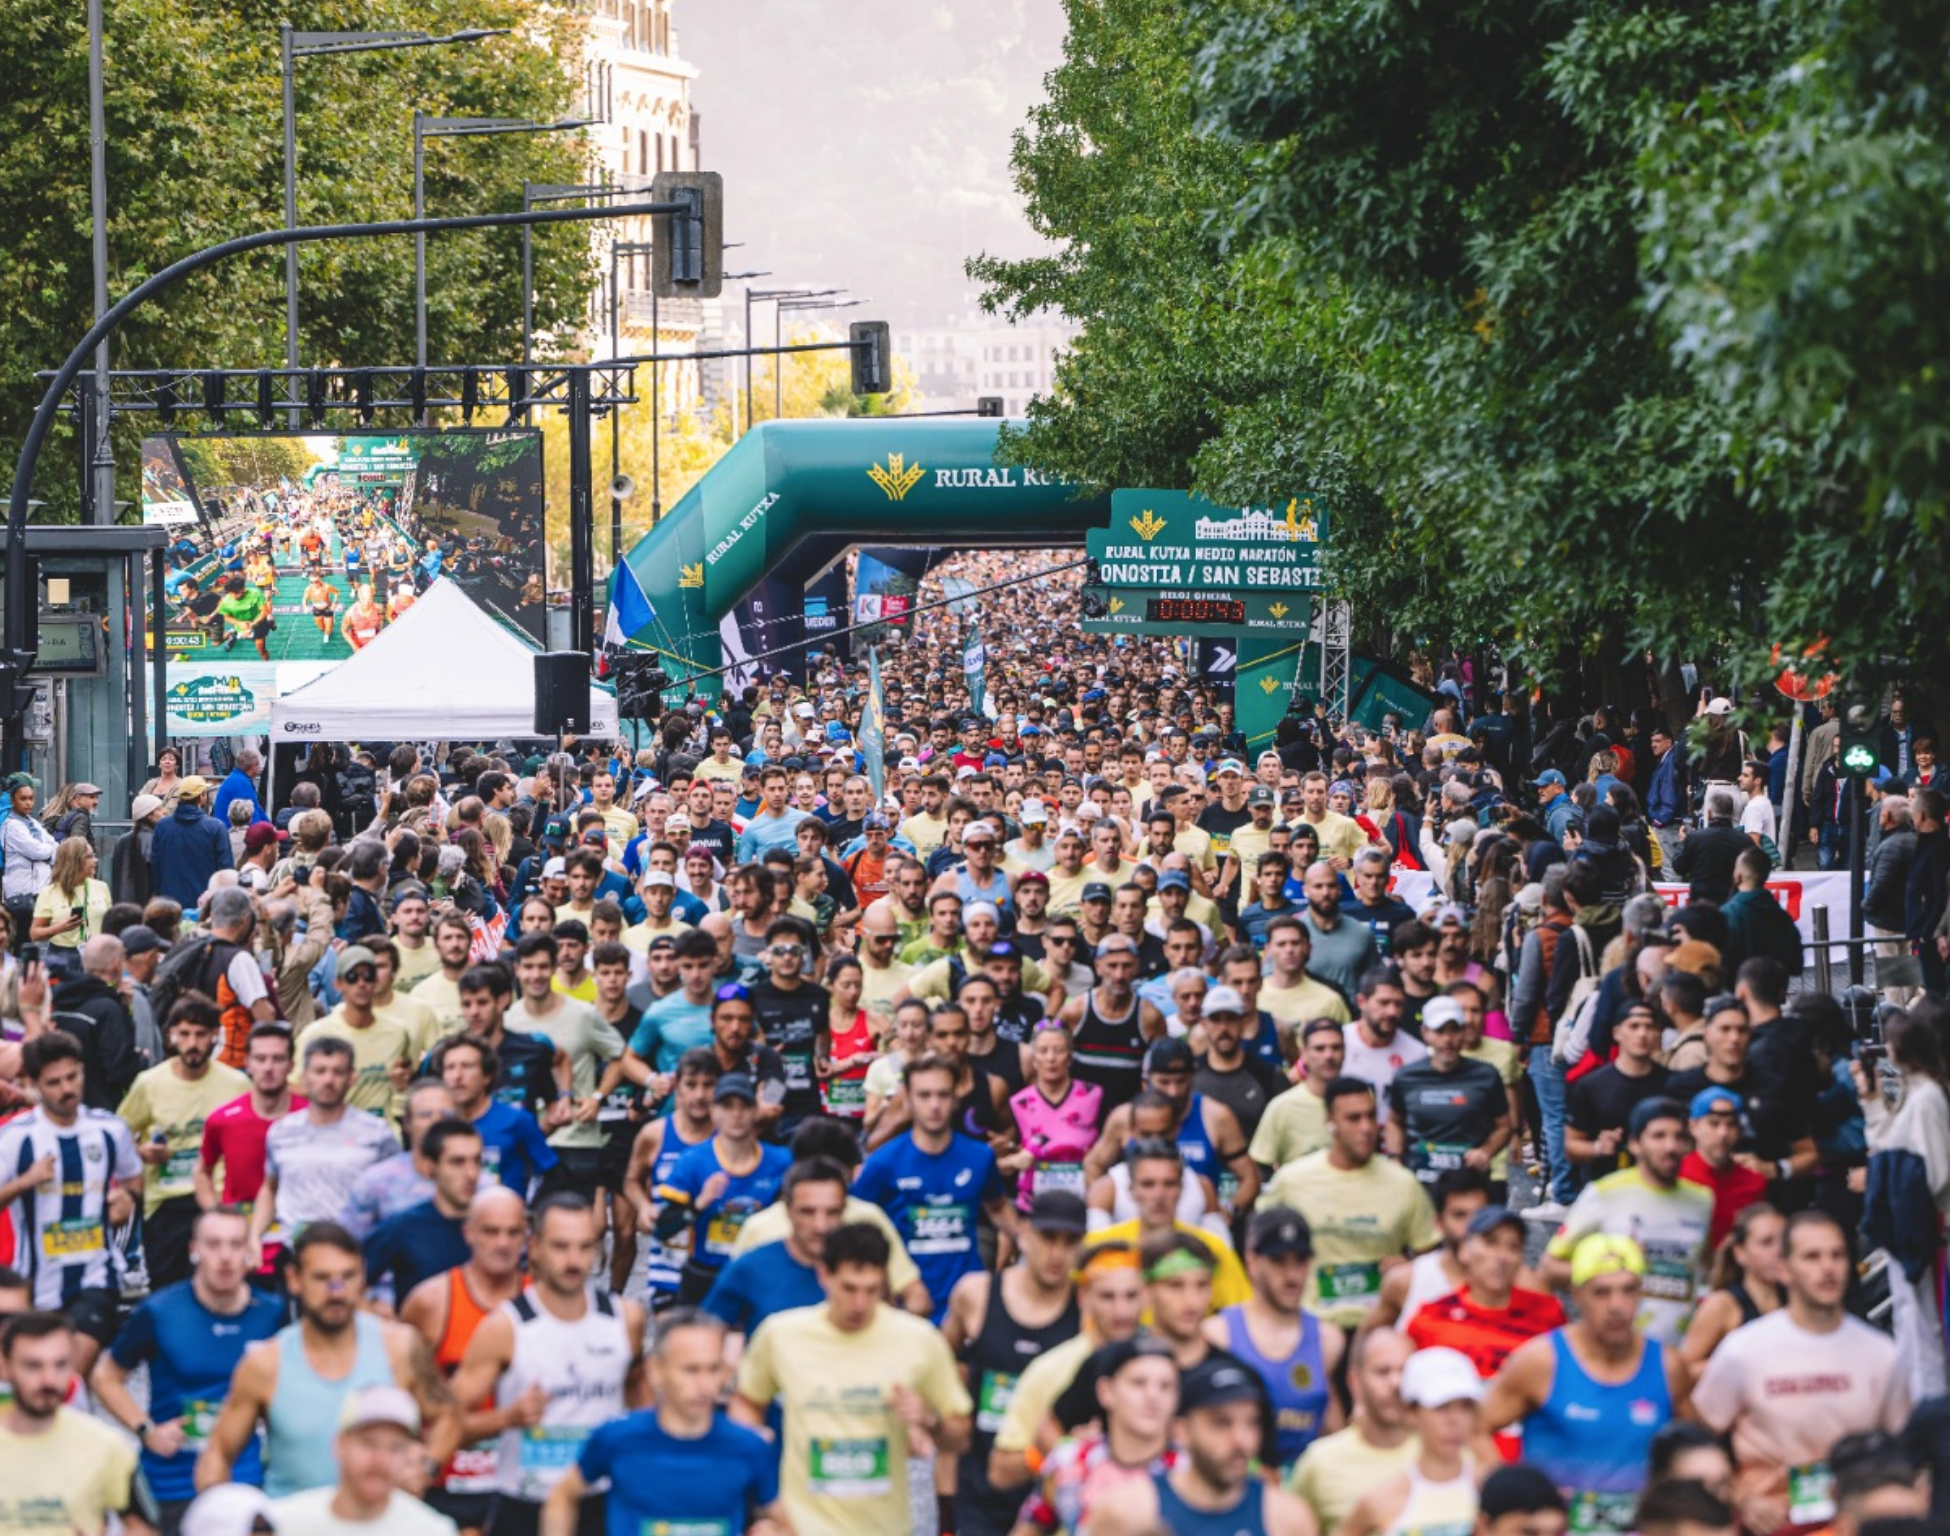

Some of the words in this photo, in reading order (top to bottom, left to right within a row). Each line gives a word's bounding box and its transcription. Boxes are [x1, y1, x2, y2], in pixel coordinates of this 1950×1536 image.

[934, 467, 1016, 487] RURAL
[705, 529, 743, 565] RURAL
[739, 491, 781, 531] KUTXA
[1105, 545, 1146, 560] RURAL
[1150, 546, 1191, 561] KUTXA
[1195, 547, 1237, 562] MEDIO
[1239, 546, 1297, 563] MARATÓN
[1101, 563, 1182, 584] ONOSTIA
[1203, 565, 1240, 585] SAN
[1160, 591, 1190, 600] RELOJ
[1193, 592, 1232, 601] OFICIAL
[1160, 599, 1245, 620] 0:00:43
